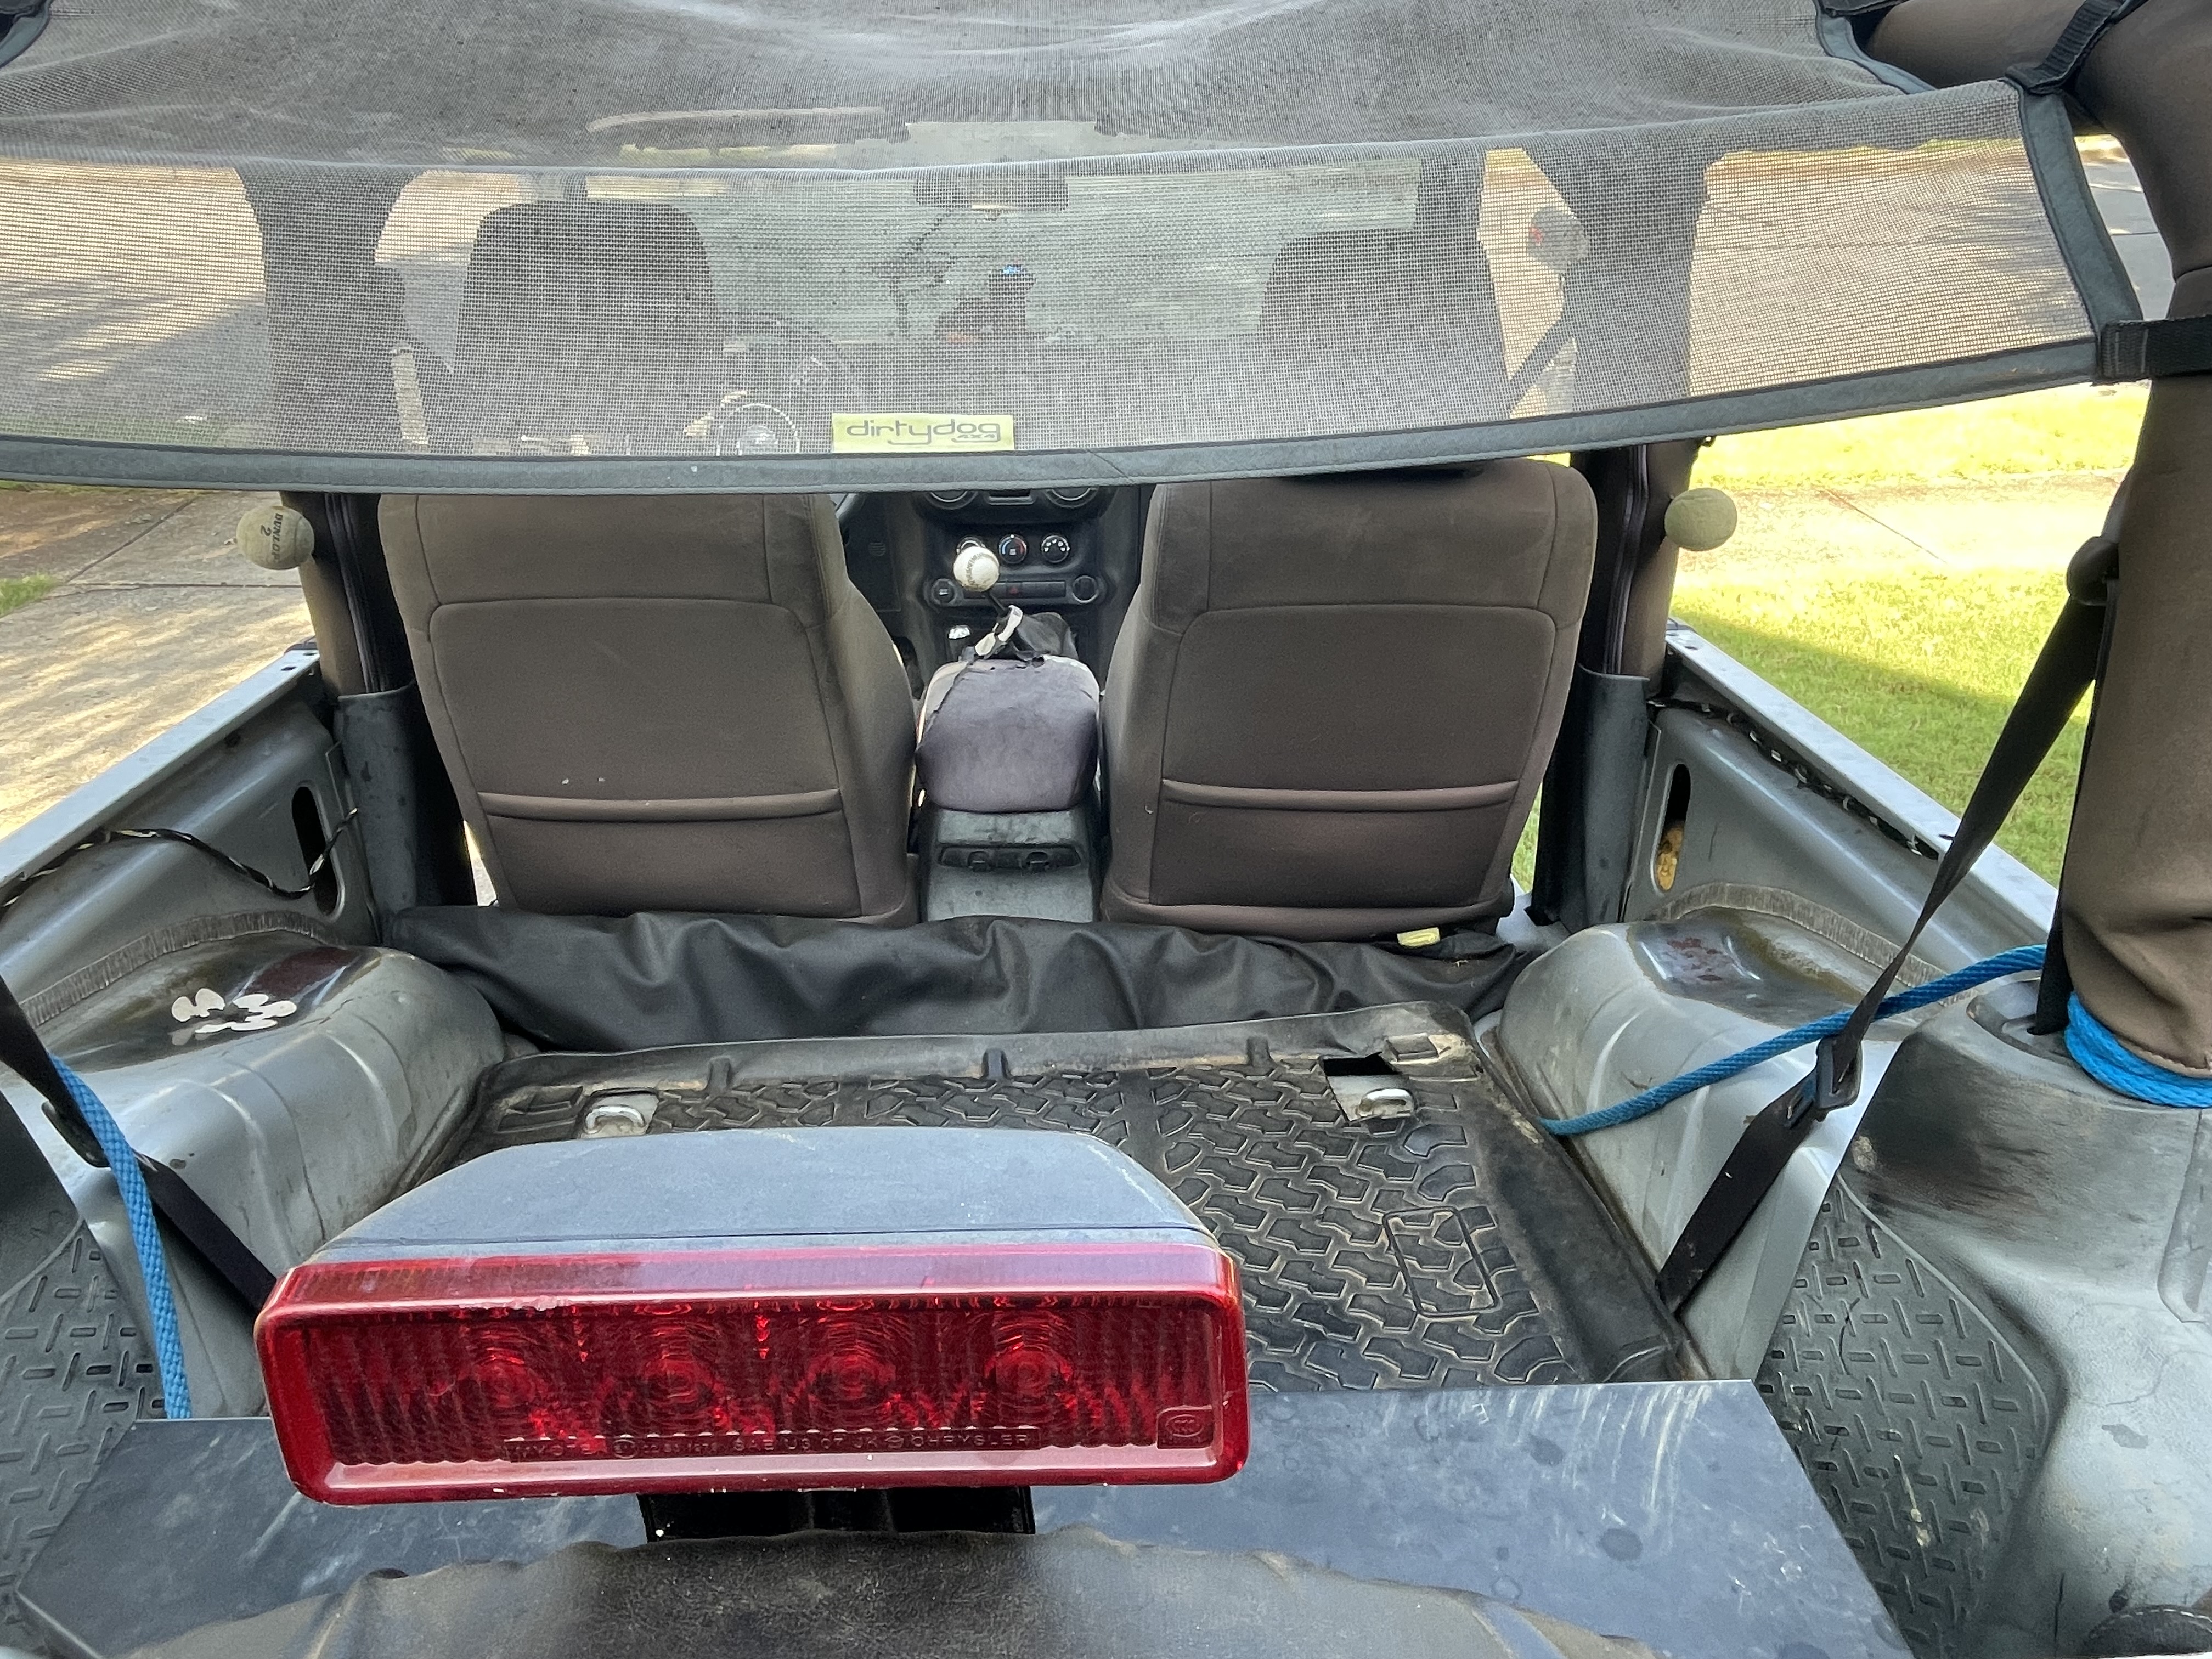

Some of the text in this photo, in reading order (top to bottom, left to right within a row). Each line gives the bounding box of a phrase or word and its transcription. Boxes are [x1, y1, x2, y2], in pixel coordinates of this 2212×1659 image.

[846, 418, 1001, 445] dirtydog
[260, 524, 272, 537] 2
[271, 512, 283, 560] DUNLOP
[733, 1438, 775, 1451] SAE
